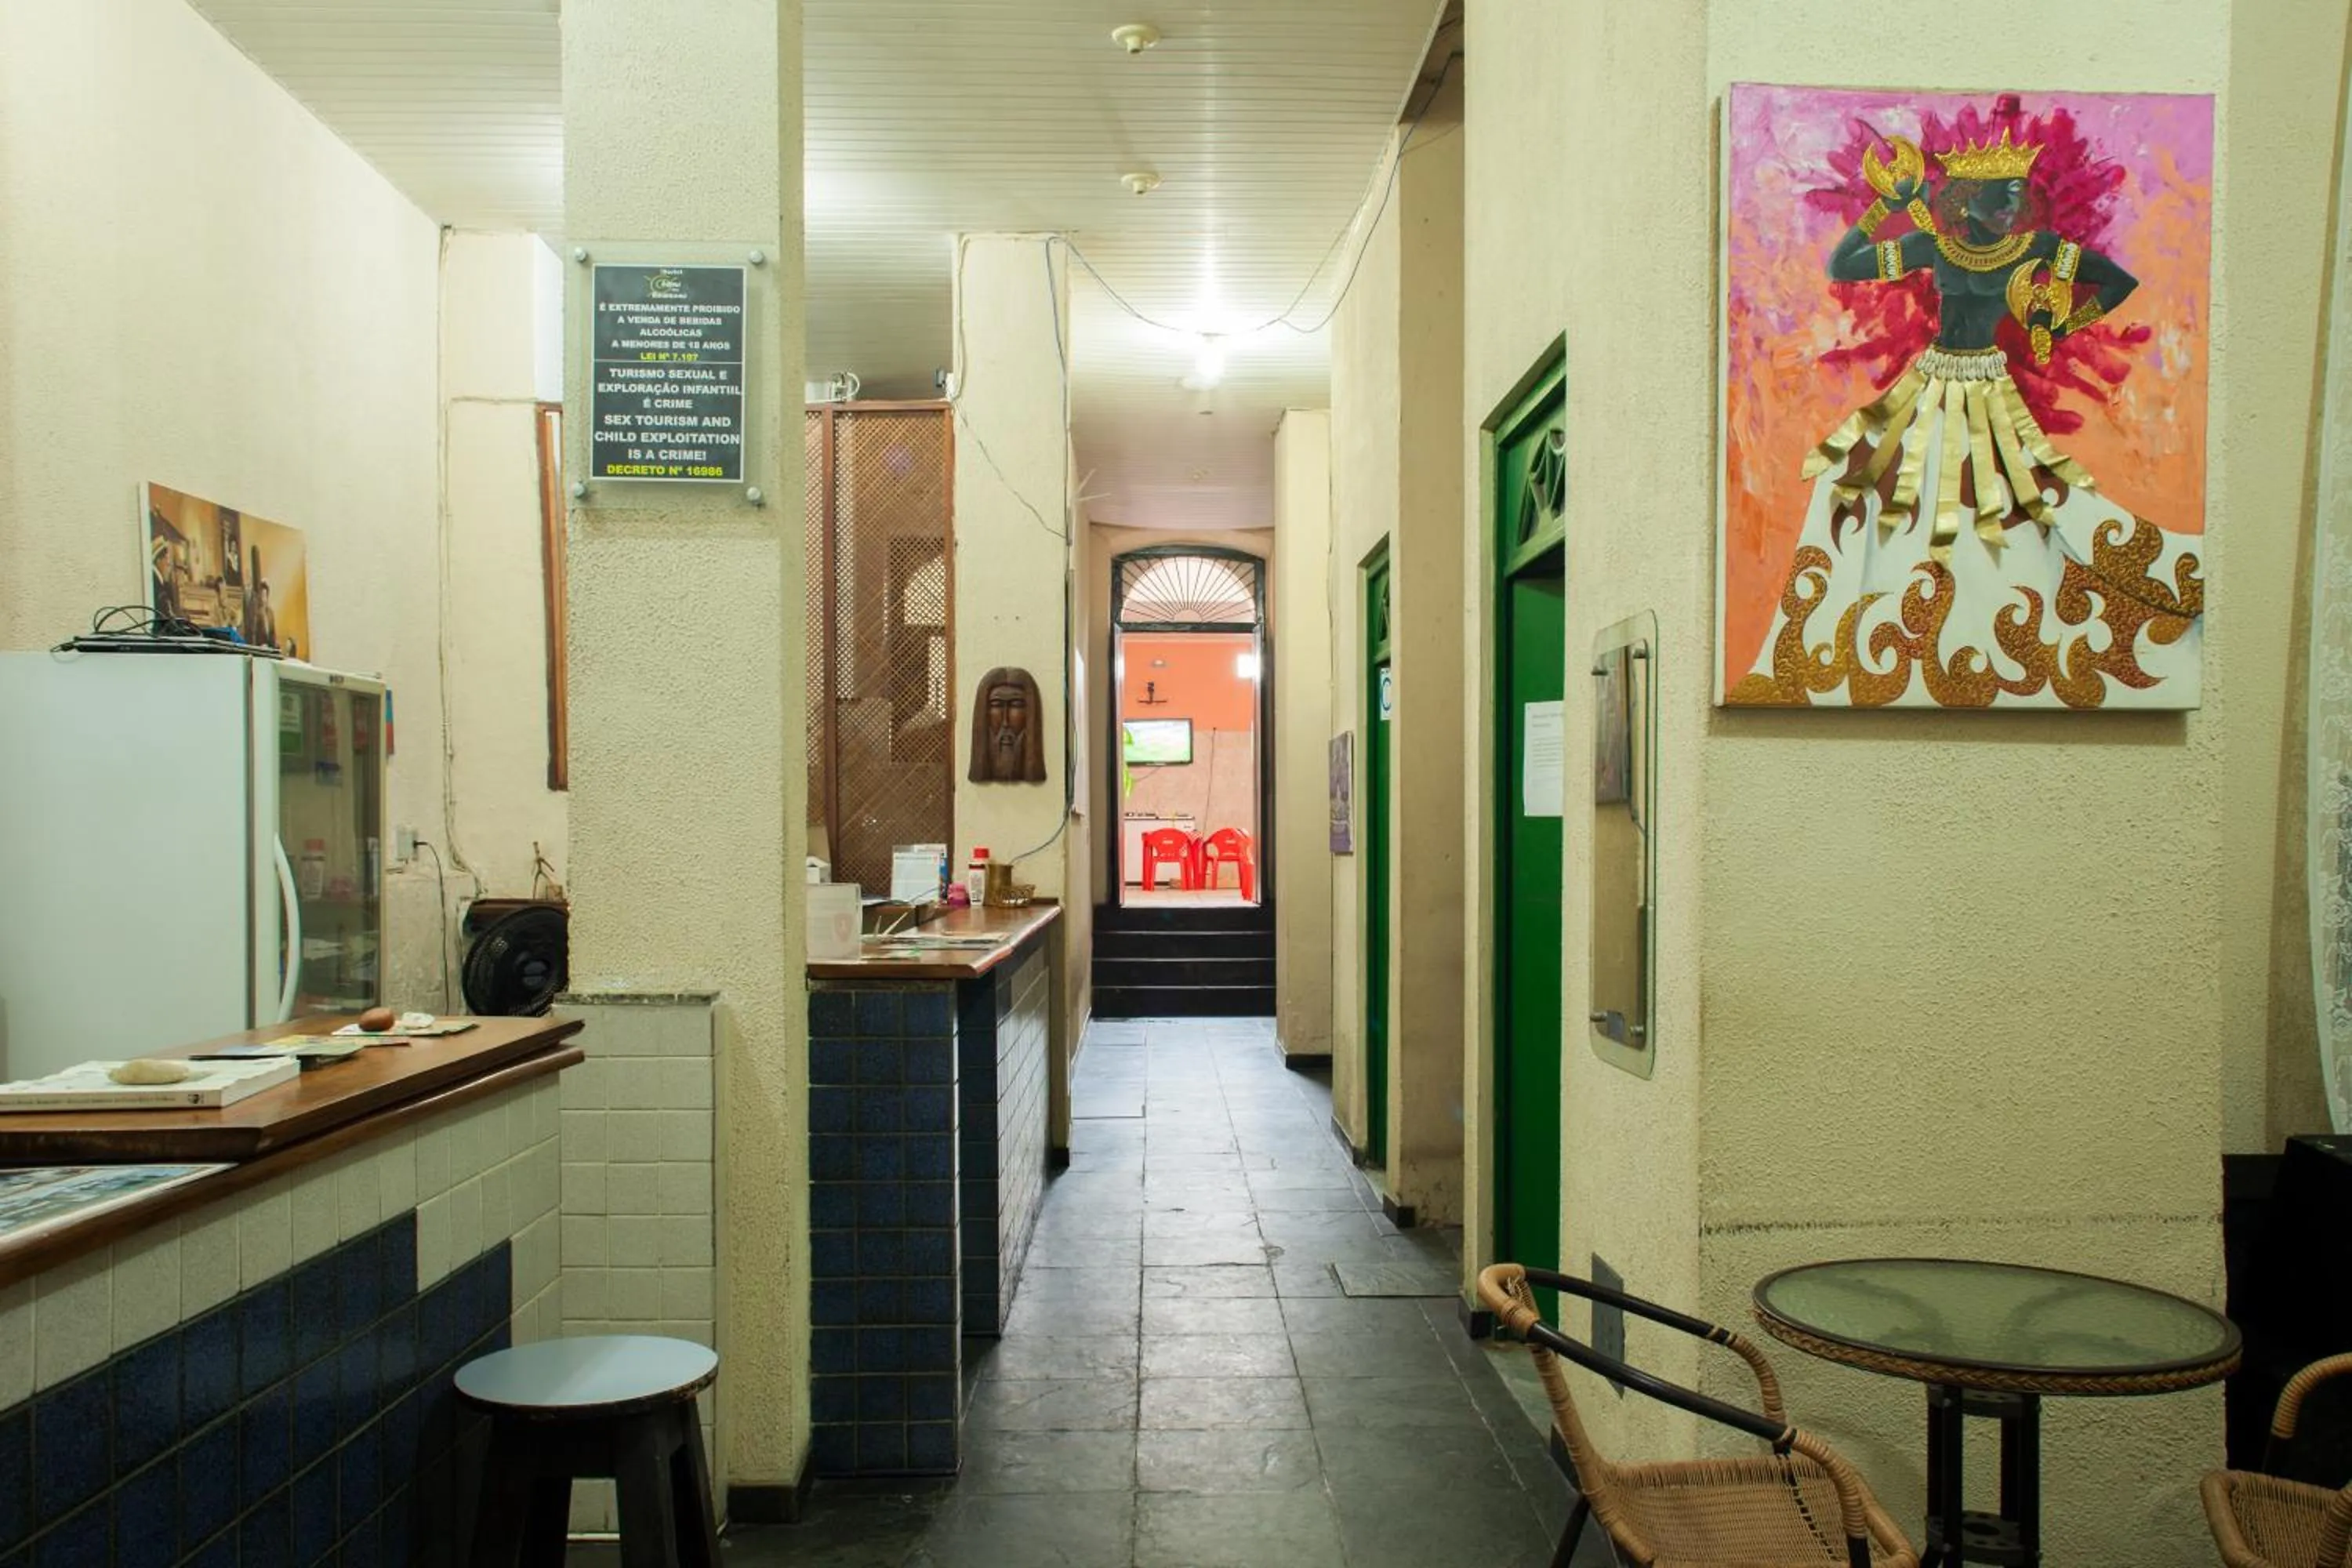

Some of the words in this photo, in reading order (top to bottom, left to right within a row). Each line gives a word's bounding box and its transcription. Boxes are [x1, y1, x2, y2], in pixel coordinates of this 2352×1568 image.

[599, 302, 606, 311] É
[609, 303, 690, 312] EXTREMAMENTE
[640, 328, 702, 337] ALCOÓLICAS
[621, 340, 670, 349] MENORES
[609, 368, 665, 379] TURISMO
[669, 369, 716, 379] SEXUAL
[719, 371, 727, 379] E
[597, 382, 679, 395] EXPLORAÇÃO
[643, 397, 651, 408] É
[655, 399, 693, 408] CRIME
[604, 415, 631, 425] SEX
[635, 415, 698, 426] TOURISM
[702, 416, 731, 427] AND
[595, 432, 637, 441] CHILD
[641, 434, 740, 445] EXPLOITATION
[628, 449, 641, 459] IS
[646, 450, 655, 459] A
[607, 464, 665, 475] DECRETO
